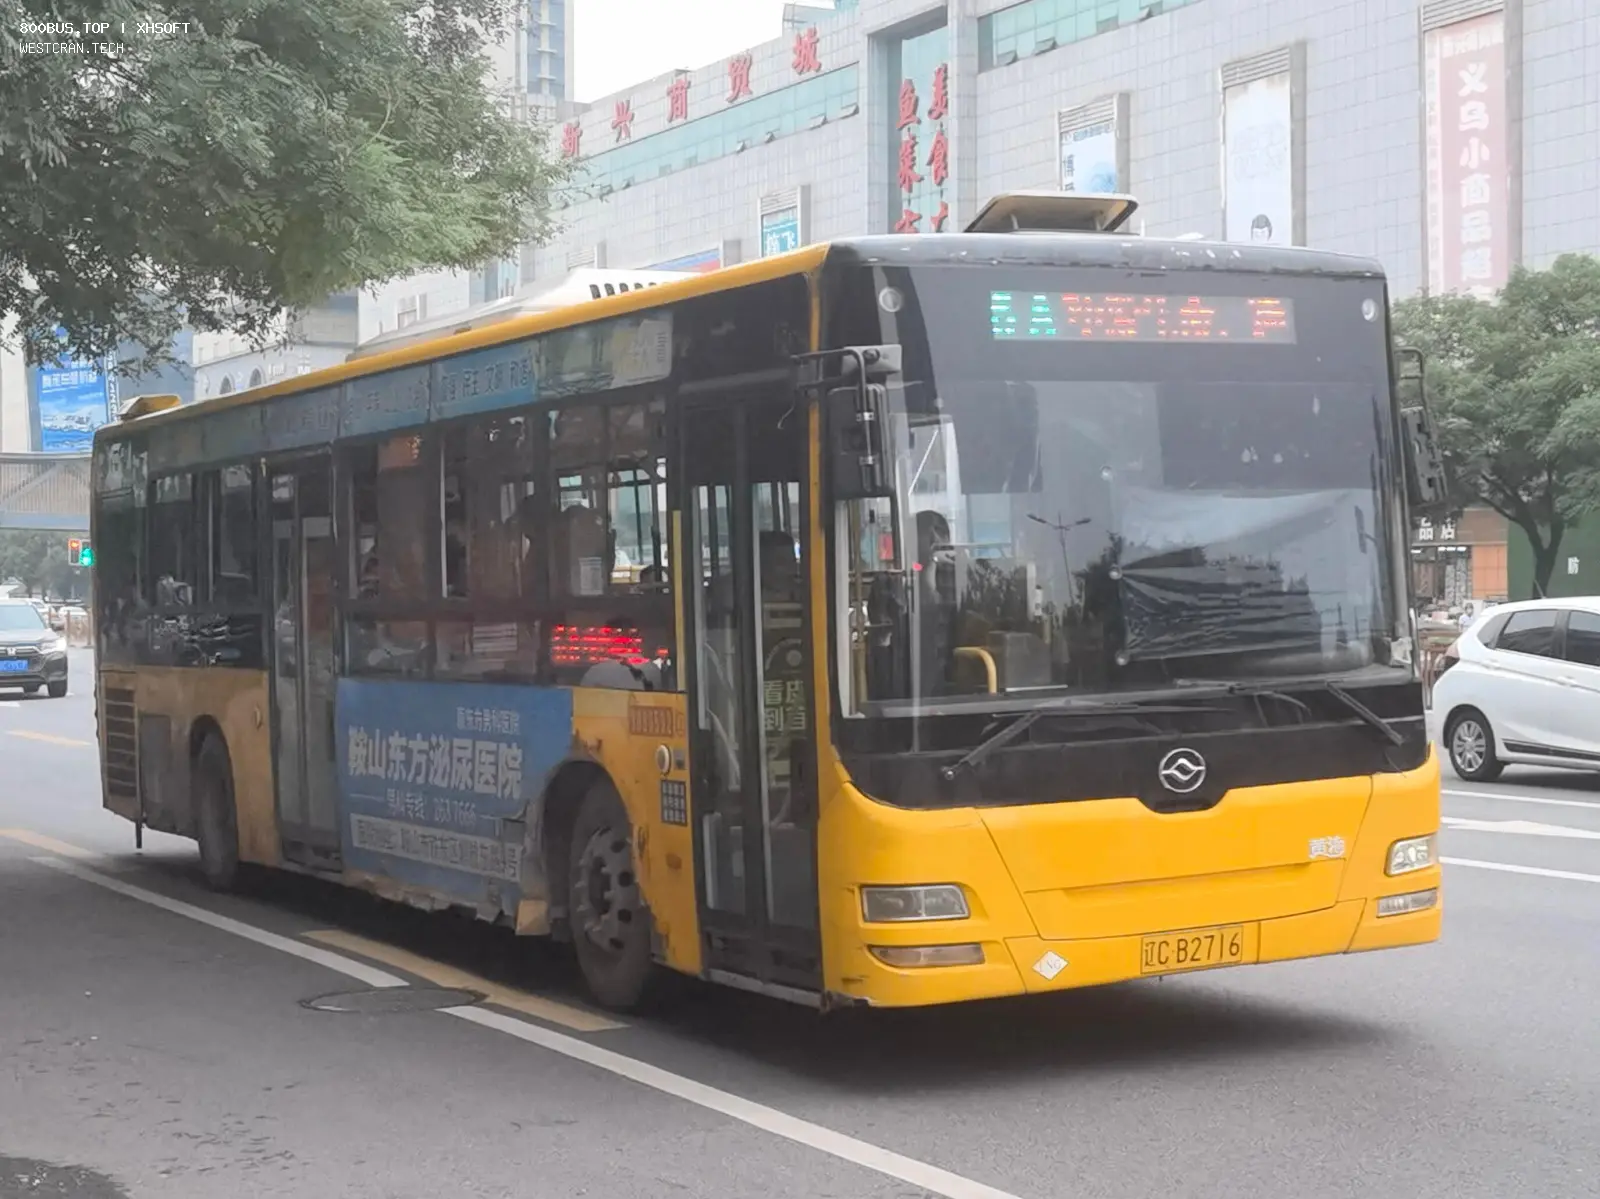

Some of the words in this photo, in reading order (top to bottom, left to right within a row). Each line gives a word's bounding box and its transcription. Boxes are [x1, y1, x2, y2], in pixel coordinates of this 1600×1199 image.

[561, 27, 823, 158] 新兴商贸城
[348, 724, 523, 799] 鞍山东方泌尿医院
